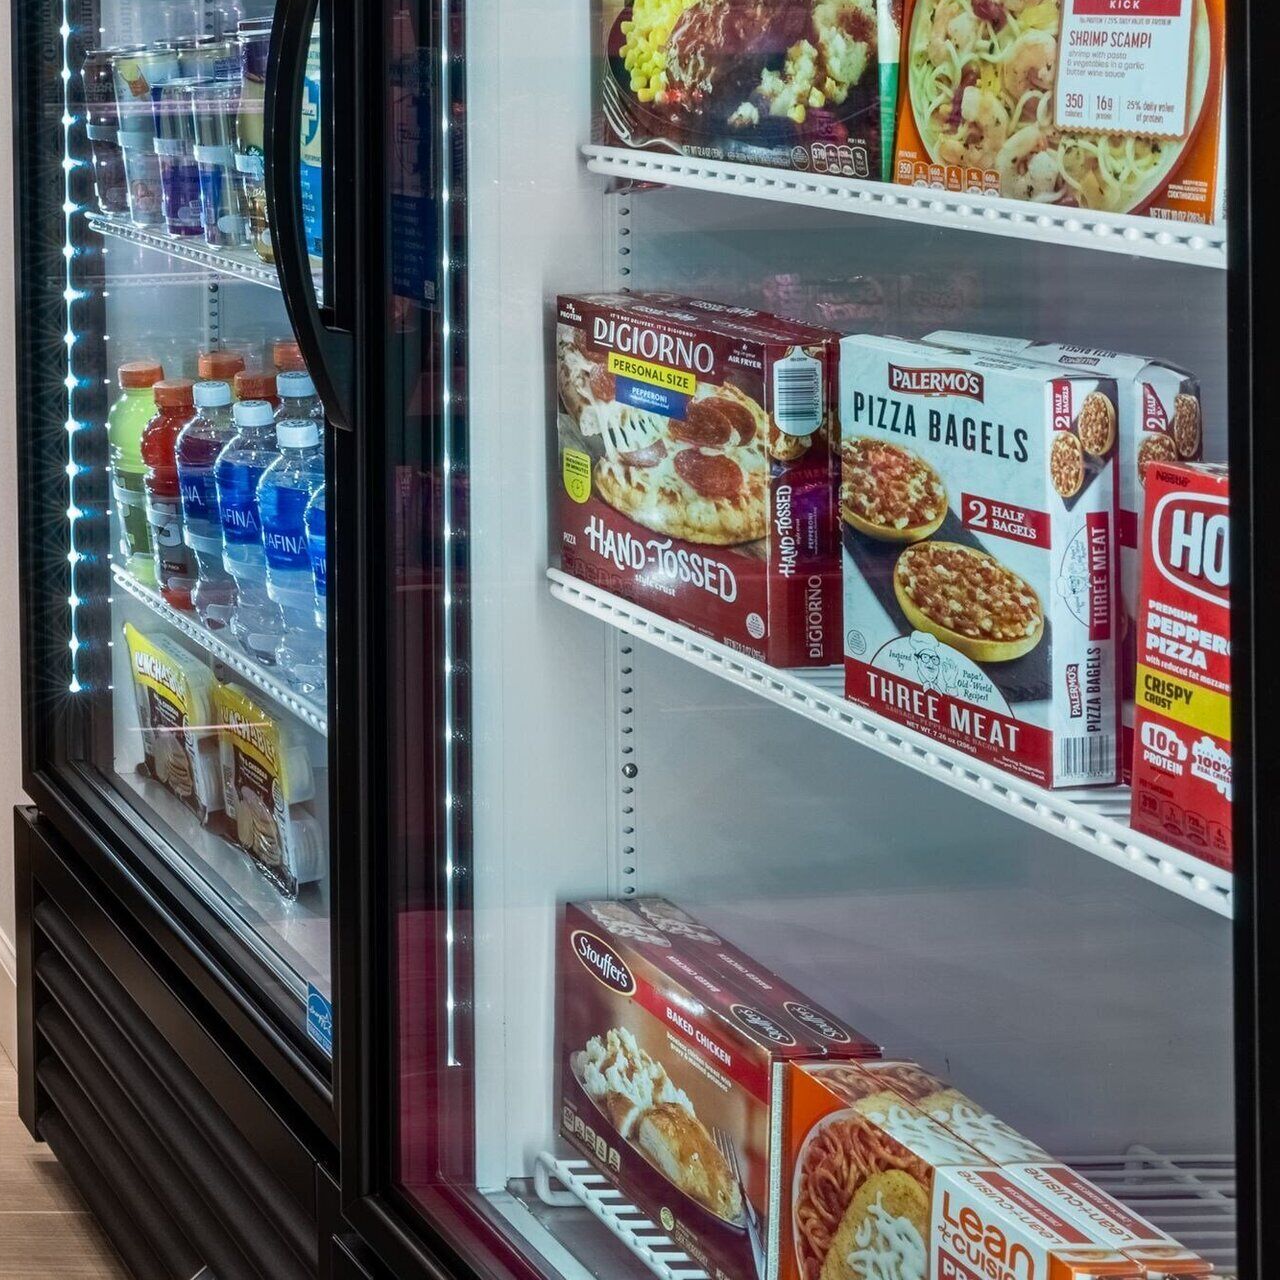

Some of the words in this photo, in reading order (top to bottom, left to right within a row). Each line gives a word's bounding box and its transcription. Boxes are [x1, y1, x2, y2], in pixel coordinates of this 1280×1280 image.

[1109, 0, 1140, 11] KICK
[1069, 31, 1108, 48] SHRIMP
[1110, 32, 1152, 49] SCAMPI
[613, 358, 665, 384] PERSONAL
[666, 373, 690, 389] SIZE
[892, 370, 980, 397] PALERMO'S
[853, 390, 918, 437] PIZZA
[928, 407, 1029, 463] BAGELS
[968, 500, 988, 529] 2
[991, 507, 1025, 524] HALF
[992, 518, 1037, 540] BAGELS
[584, 515, 738, 603] HAND-TOSSED
[1149, 600, 1198, 624] PREMIUM
[1146, 635, 1208, 670] PIZZA
[1144, 690, 1172, 711] CRUST
[1145, 673, 1193, 706] CRISPY
[867, 671, 941, 723] THREE
[949, 707, 1019, 753] MEAT
[1143, 750, 1184, 776] PROTEIN
[577, 933, 628, 988] Stouffer's
[666, 1007, 694, 1035] BAKED
[695, 1029, 732, 1067] CHICKEN
